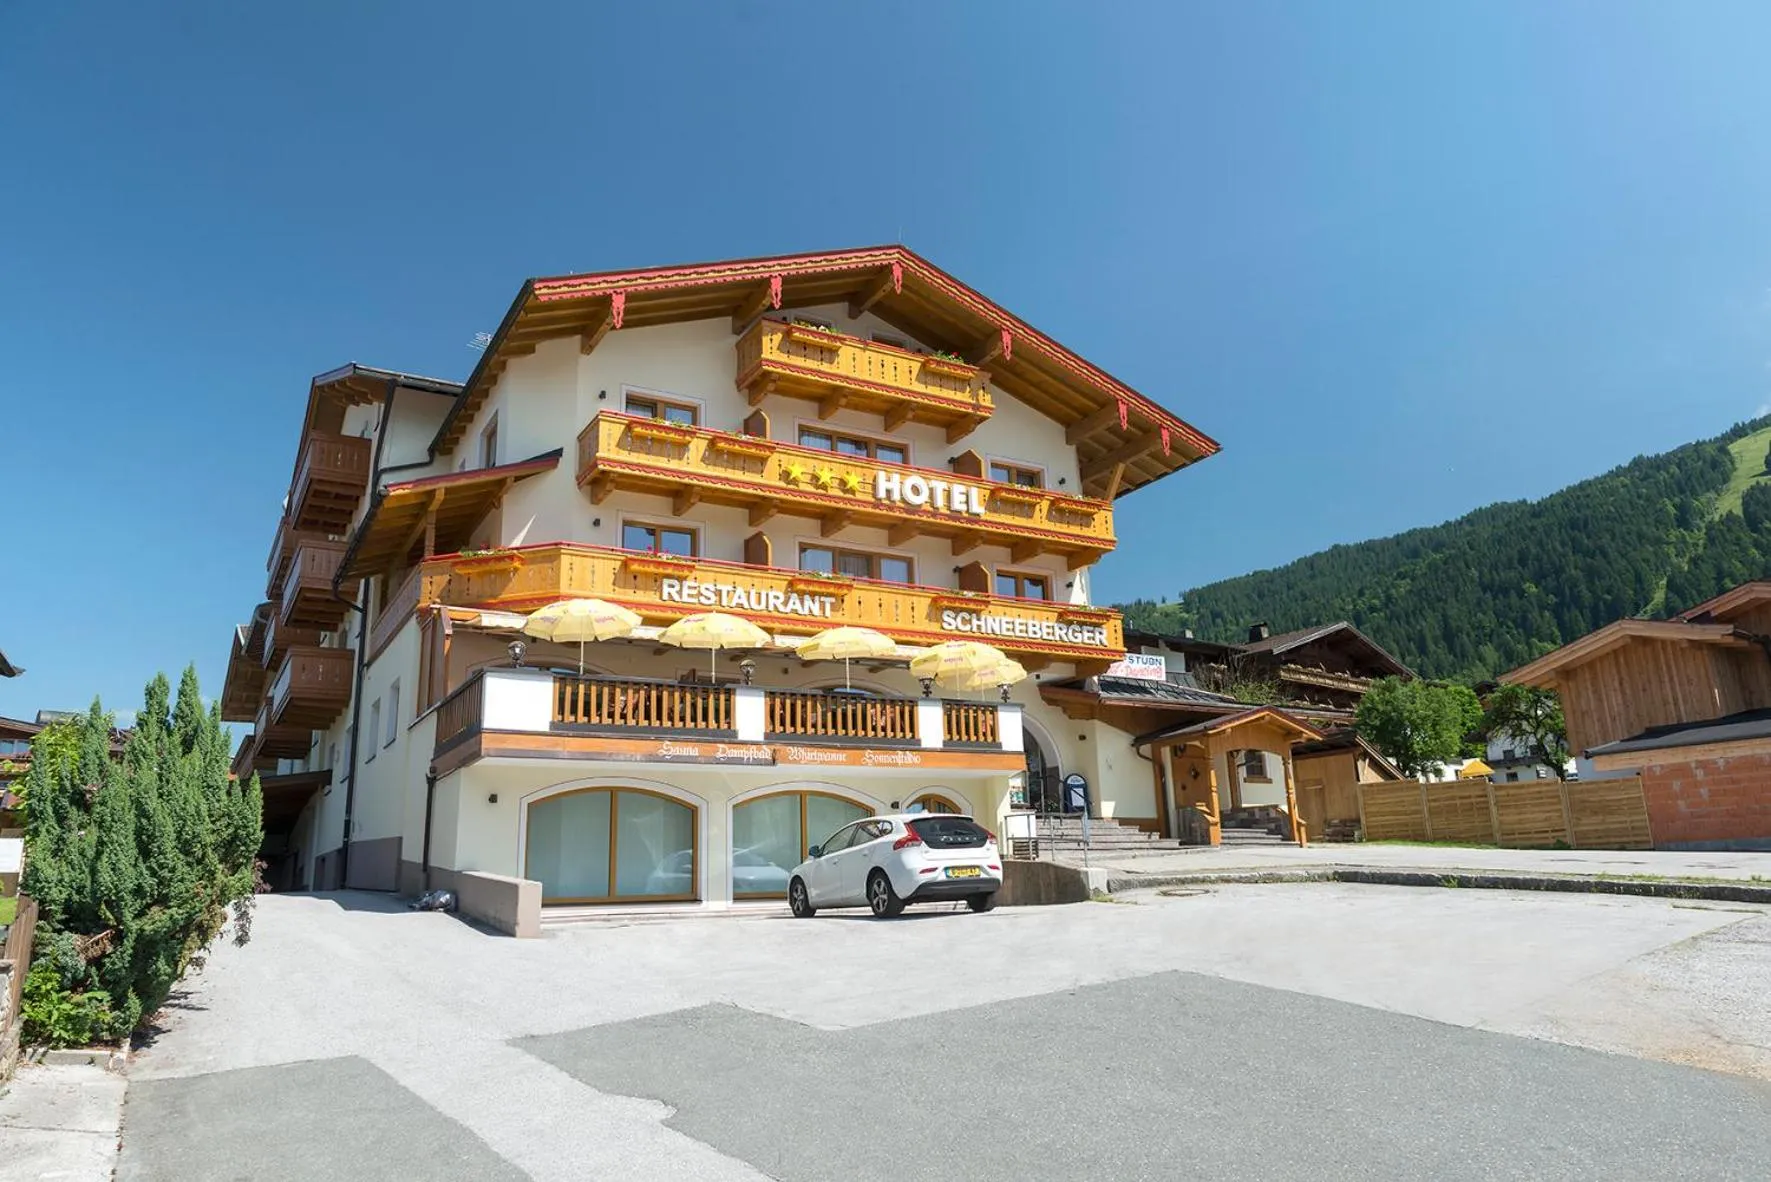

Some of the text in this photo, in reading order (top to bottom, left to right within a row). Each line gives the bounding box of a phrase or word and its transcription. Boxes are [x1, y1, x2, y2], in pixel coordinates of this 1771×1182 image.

[875, 470, 986, 515] HOTEL
[661, 578, 836, 618] RESTAURANT
[941, 609, 1109, 647] SCHNEEBERGER
[658, 741, 699, 759] Sauna
[713, 744, 772, 762] Dampfbad
